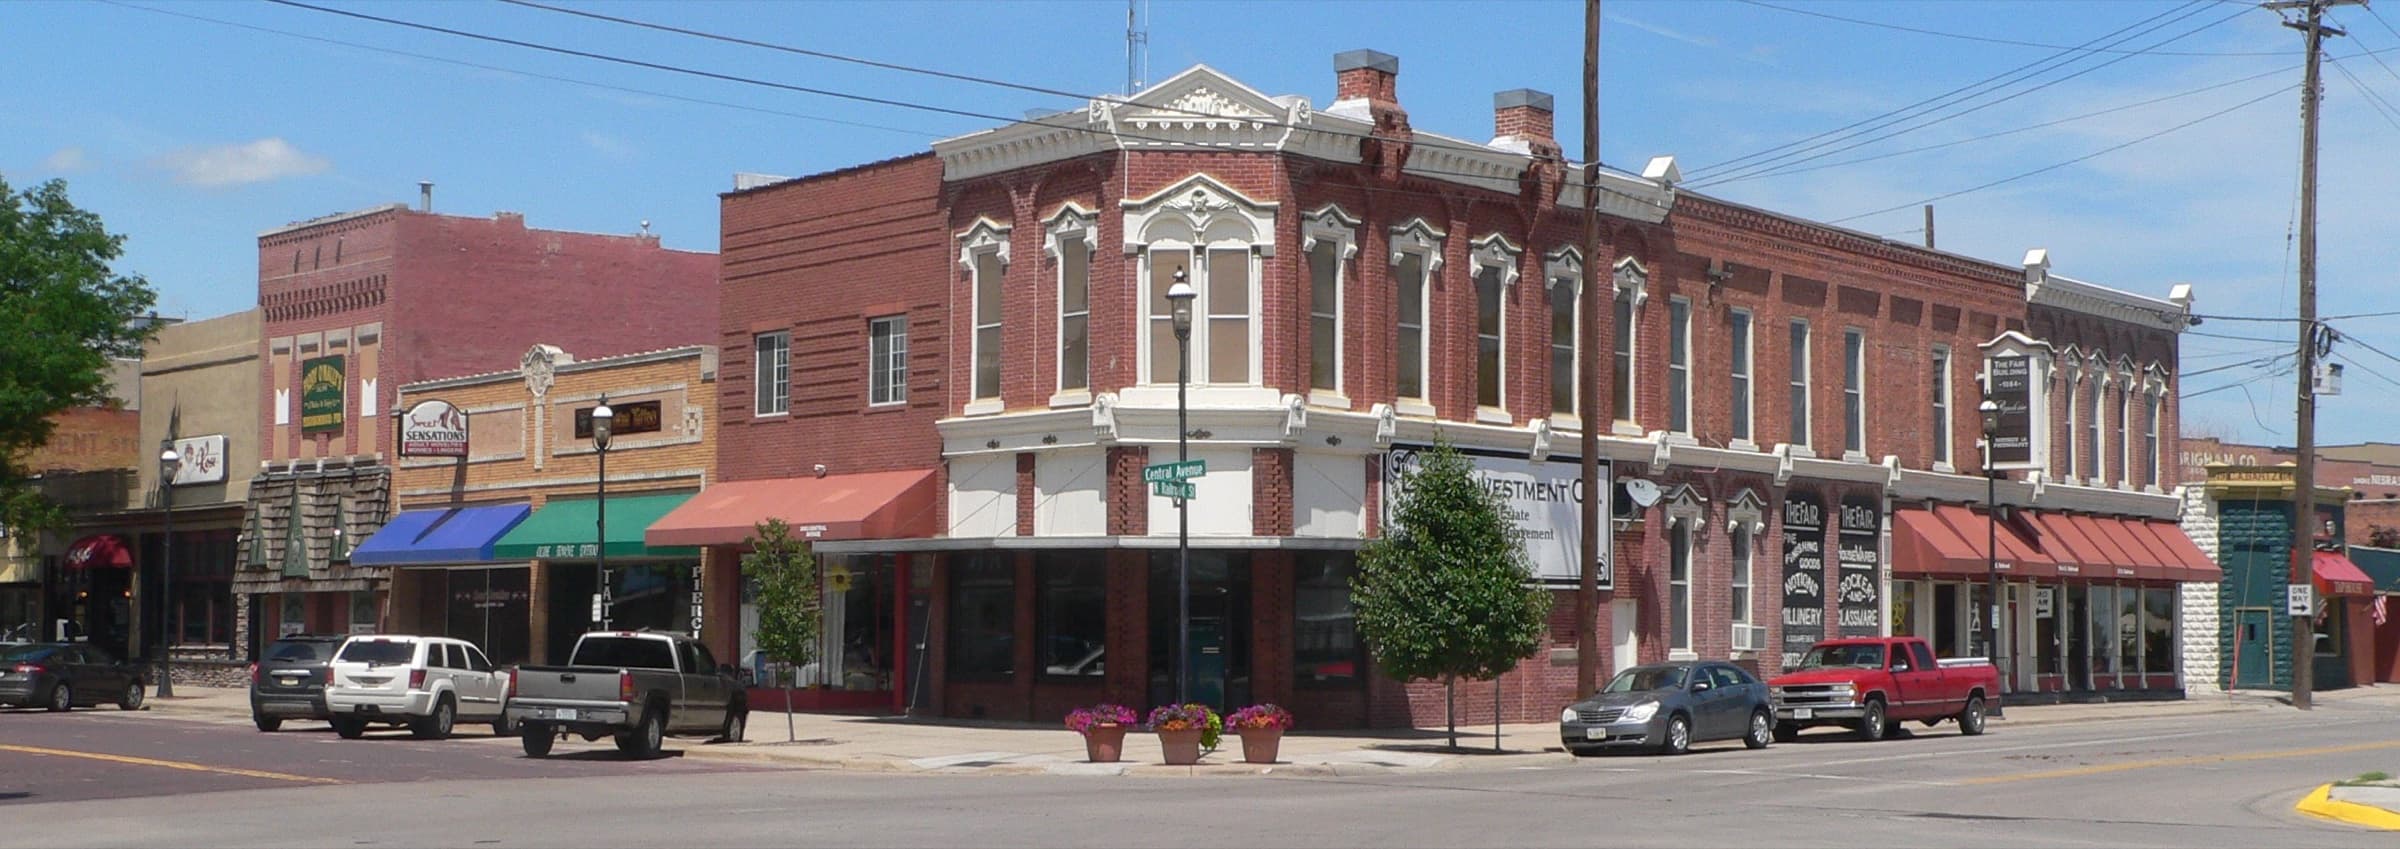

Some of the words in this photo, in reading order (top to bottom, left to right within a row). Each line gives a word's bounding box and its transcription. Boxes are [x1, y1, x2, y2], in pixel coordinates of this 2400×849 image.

[2009, 360, 2025, 368] FAIR
[1993, 368, 2027, 376] BUILDING
[405, 430, 465, 441] SENSATIONS
[1145, 465, 1172, 481] Central
[1176, 464, 1203, 479] Avenue
[1470, 475, 1568, 504] VESTMENT
[1799, 557, 1821, 570] GOODS
[1785, 572, 1819, 597] NOTIONS
